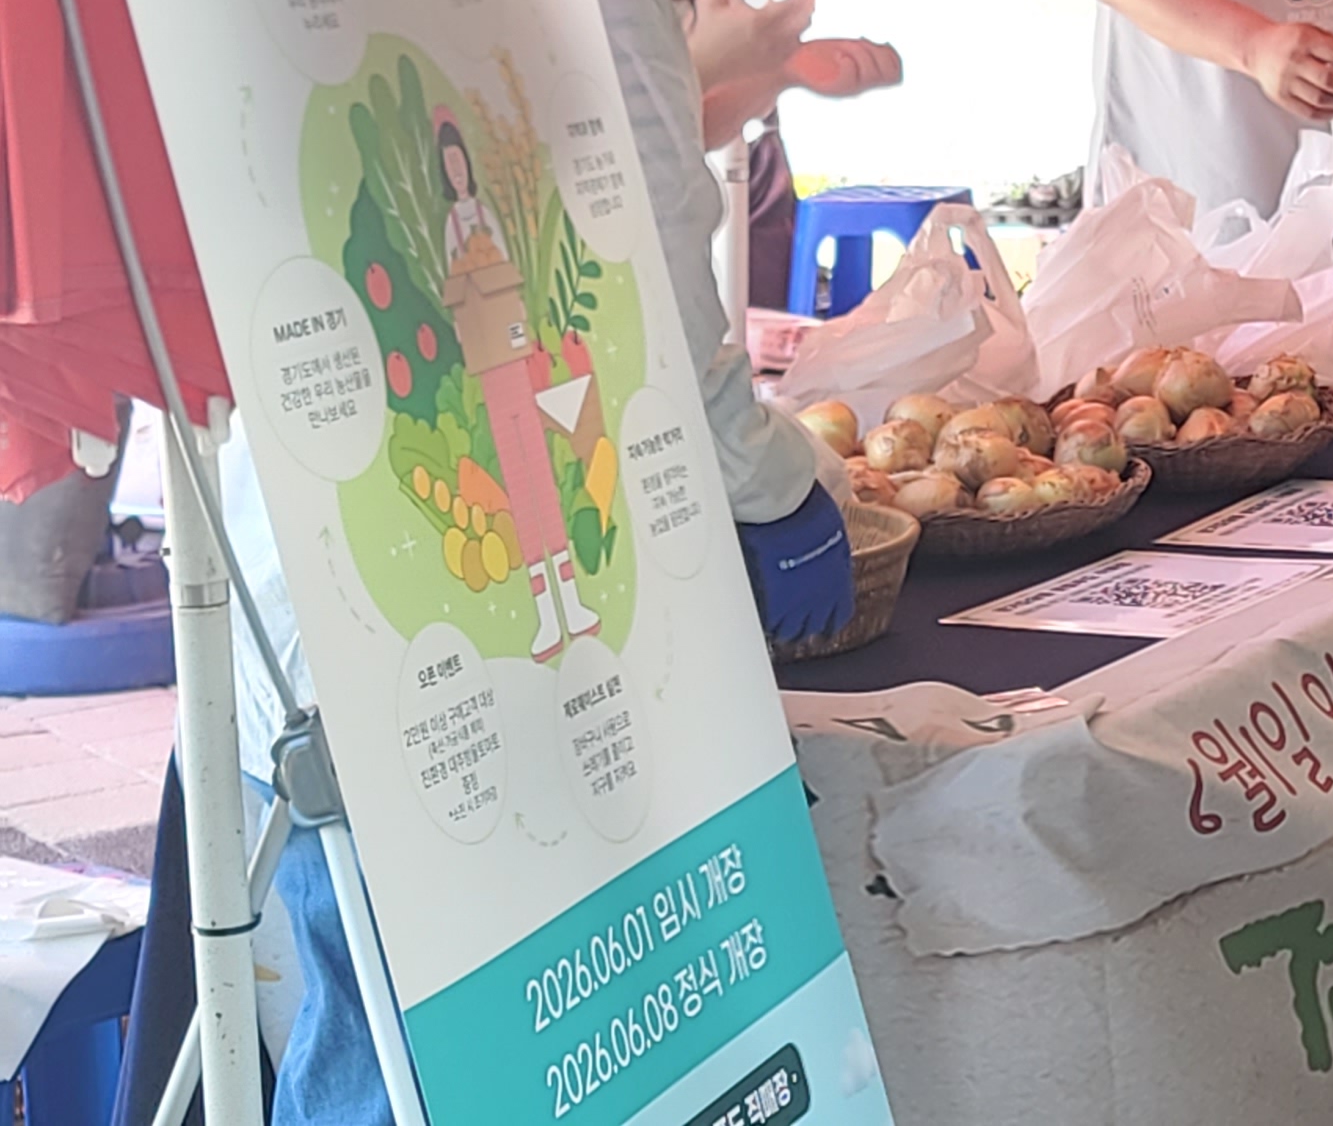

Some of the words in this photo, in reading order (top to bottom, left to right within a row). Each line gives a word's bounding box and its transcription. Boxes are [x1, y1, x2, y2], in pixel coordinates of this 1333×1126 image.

[273, 318, 311, 343] MADE
[311, 314, 325, 333] IN
[324, 307, 348, 331] 경기
[280, 353, 332, 386] 경기도에서
[314, 381, 333, 400] 우리
[307, 399, 358, 429] 만나보세요
[436, 653, 464, 679] 이벤트
[403, 720, 430, 748] 2만원
[429, 711, 448, 732] 이상
[478, 688, 495, 709] 대상
[526, 905, 655, 1033] 2026.06.01
[653, 872, 701, 942] 임시
[699, 843, 745, 909] 개장
[546, 983, 679, 1120] 2026.06.08
[674, 949, 724, 1017] 정식
[720, 918, 767, 986] 개장
